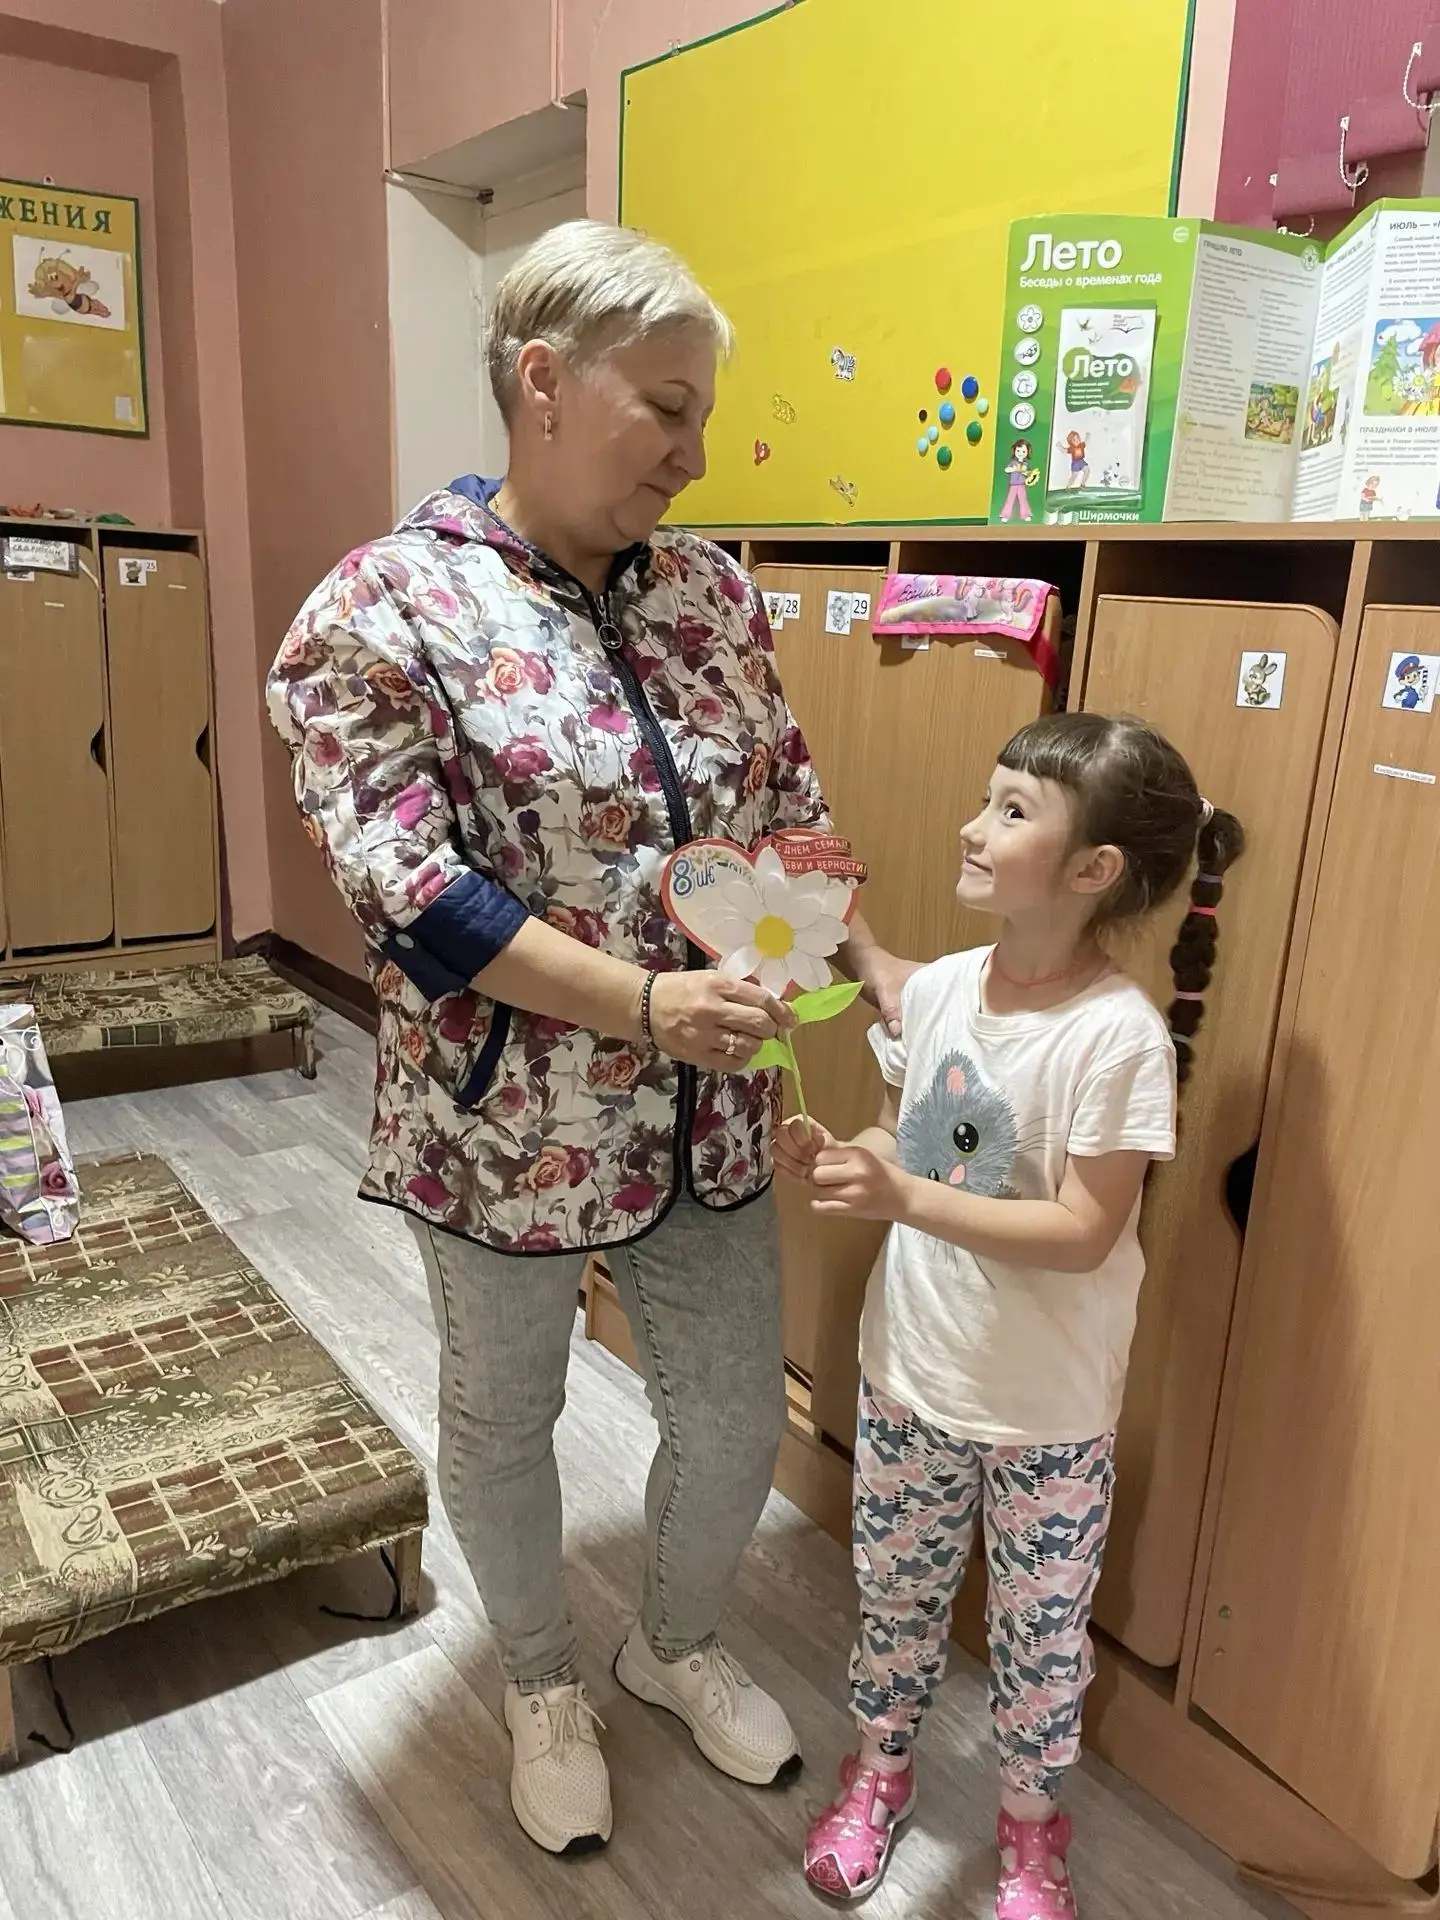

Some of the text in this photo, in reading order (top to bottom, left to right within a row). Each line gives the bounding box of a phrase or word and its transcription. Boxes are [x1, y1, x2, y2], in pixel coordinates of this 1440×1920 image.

[1020, 233, 1123, 272] Лето
[1020, 272, 1162, 288] Беседы о временах года
[1069, 354, 1133, 379] Лето
[1080, 510, 1139, 523] Ширмочки
[785, 599, 798, 614] 28
[853, 599, 868, 615] 29
[775, 843, 781, 852] С
[784, 845, 811, 855] ДНЕМ
[785, 861, 803, 870] БВИ
[807, 862, 813, 870] И
[673, 859, 693, 896] 8
